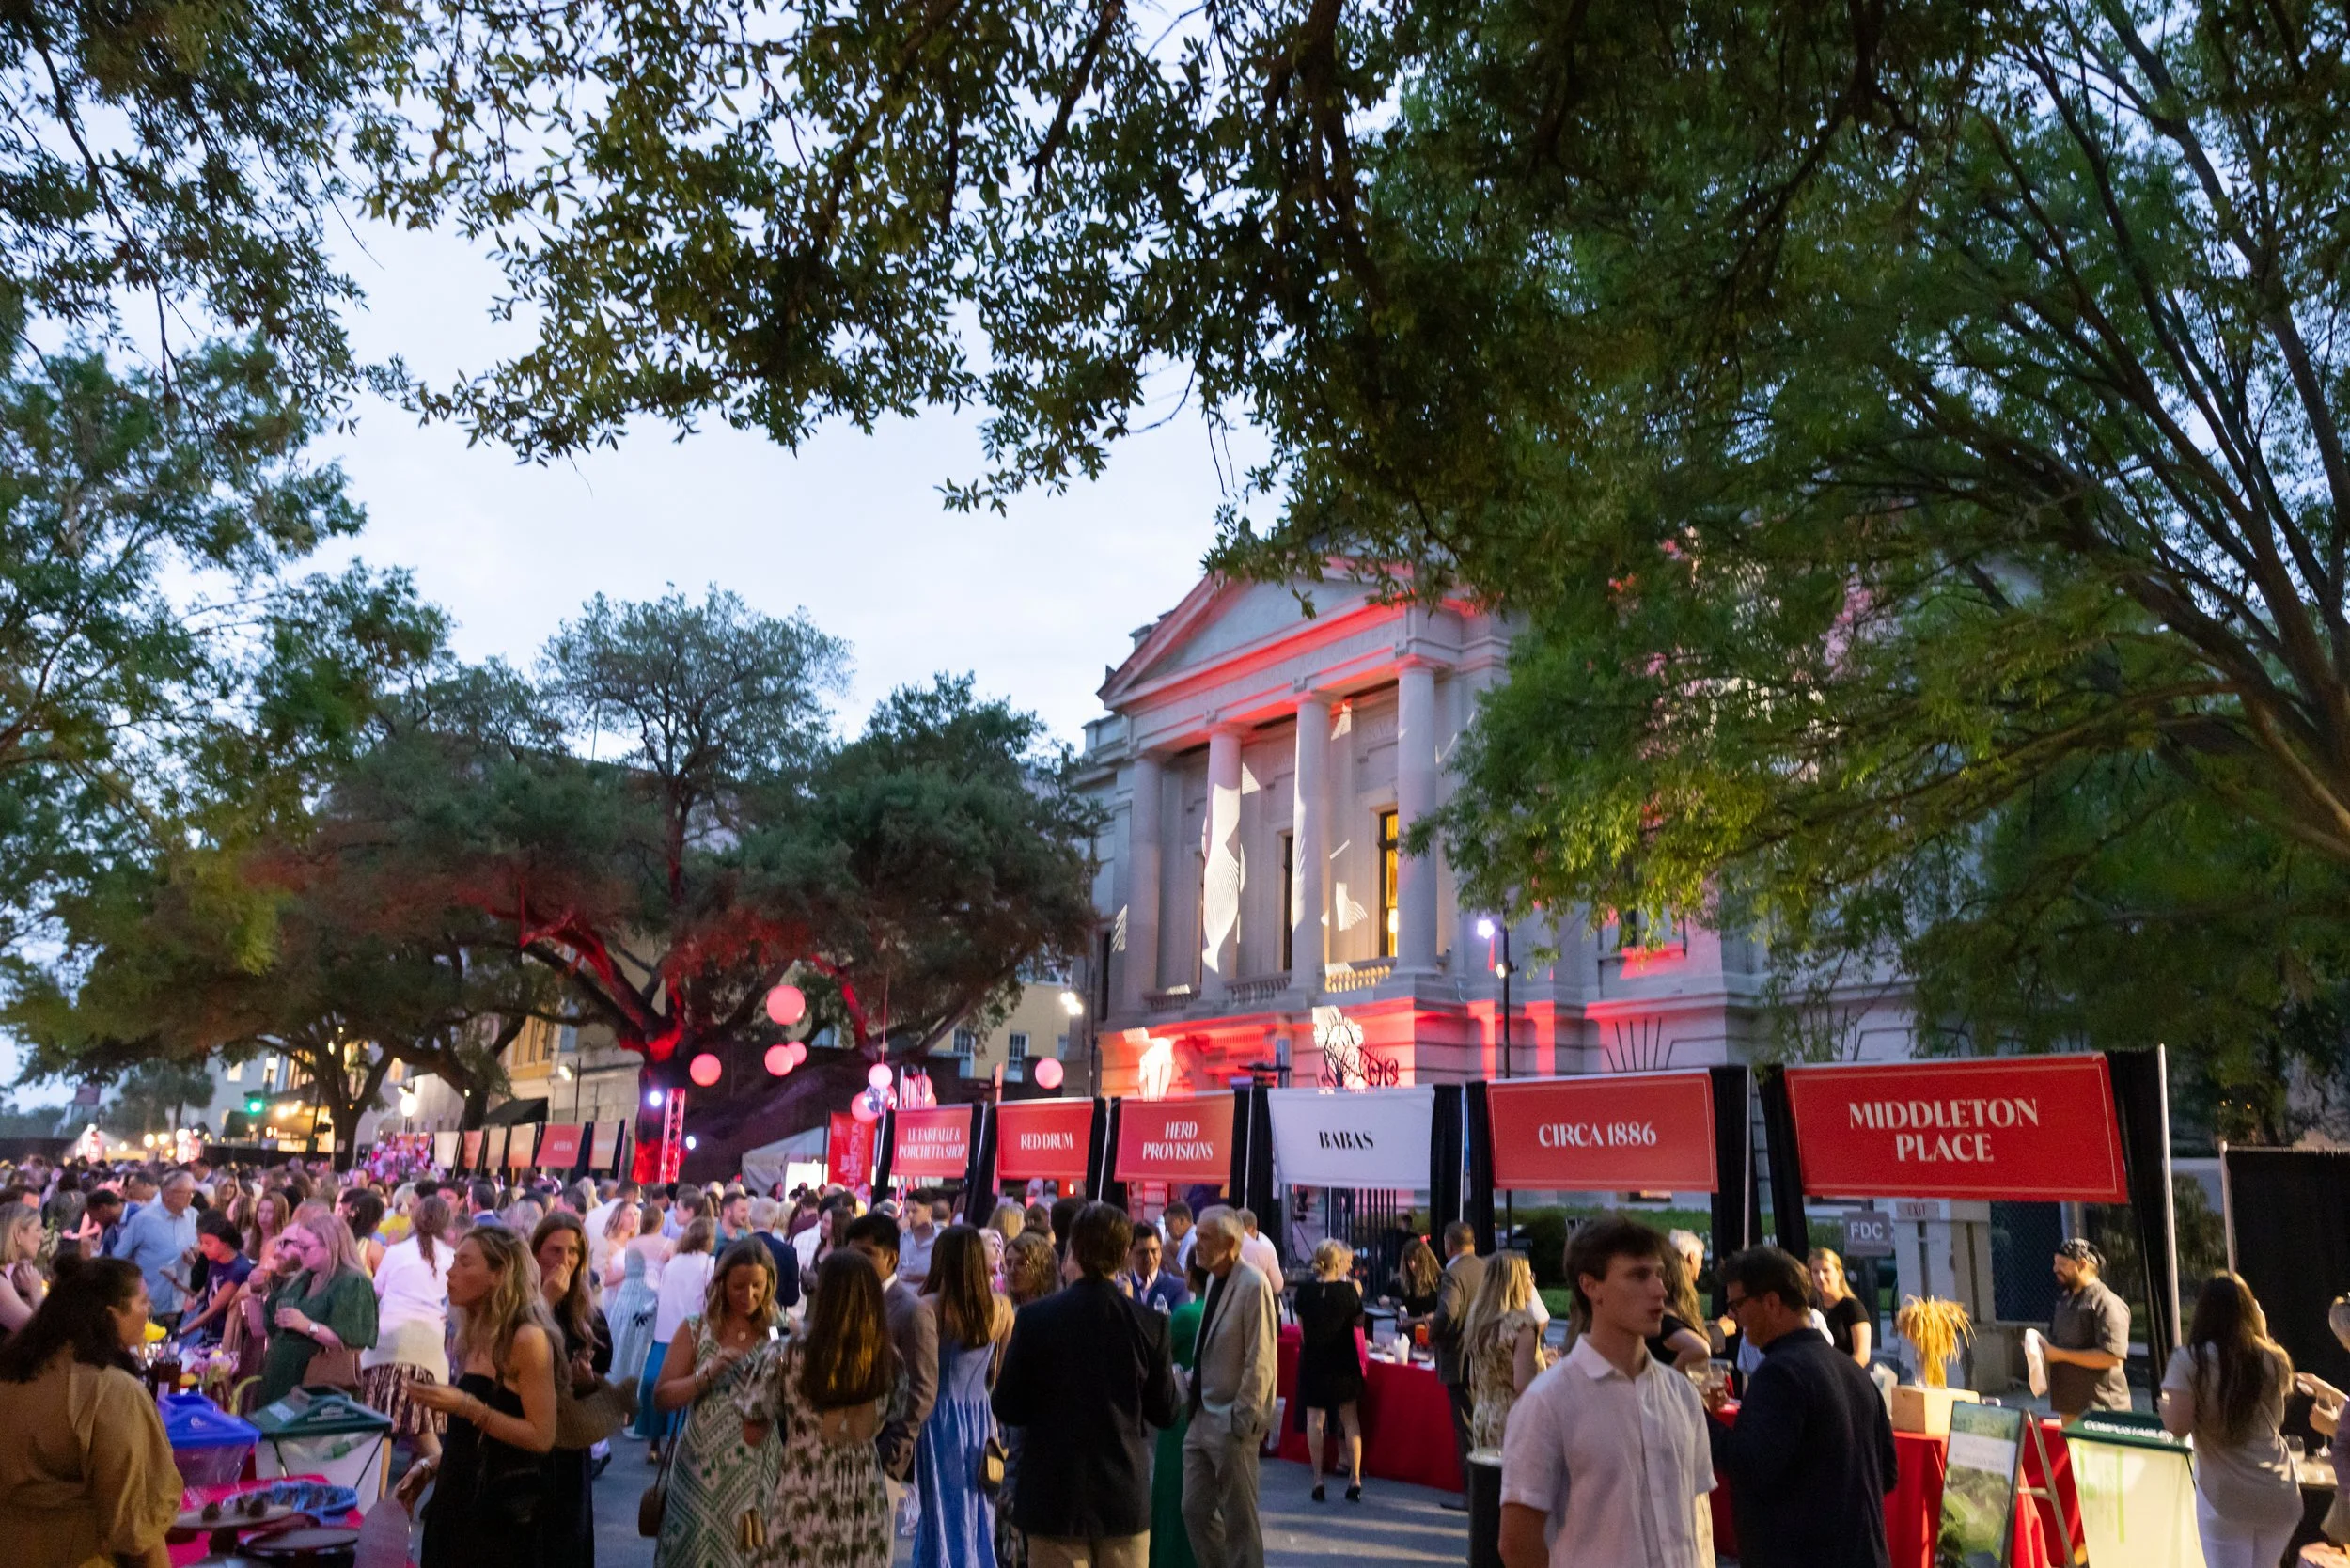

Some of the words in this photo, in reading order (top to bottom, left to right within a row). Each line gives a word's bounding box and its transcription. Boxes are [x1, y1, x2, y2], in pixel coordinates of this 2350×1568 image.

[1848, 1097, 2040, 1129] MIDDLETON
[908, 1128, 917, 1143] LE
[917, 1127, 953, 1143] FARFALLE
[1165, 1121, 1198, 1140] HERD
[1538, 1122, 1604, 1148] CIRCA
[1606, 1121, 1657, 1147] 1886
[1020, 1133, 1042, 1151] RED
[1042, 1132, 1074, 1151] DRUM
[1318, 1130, 1375, 1152] BABAS
[1895, 1132, 1995, 1163] PLACE
[898, 1143, 946, 1160] PORCHETTA
[945, 1143, 966, 1160] SHOP
[1141, 1141, 1214, 1161] PROVISIONS
[1850, 1221, 1884, 1240] FDC
